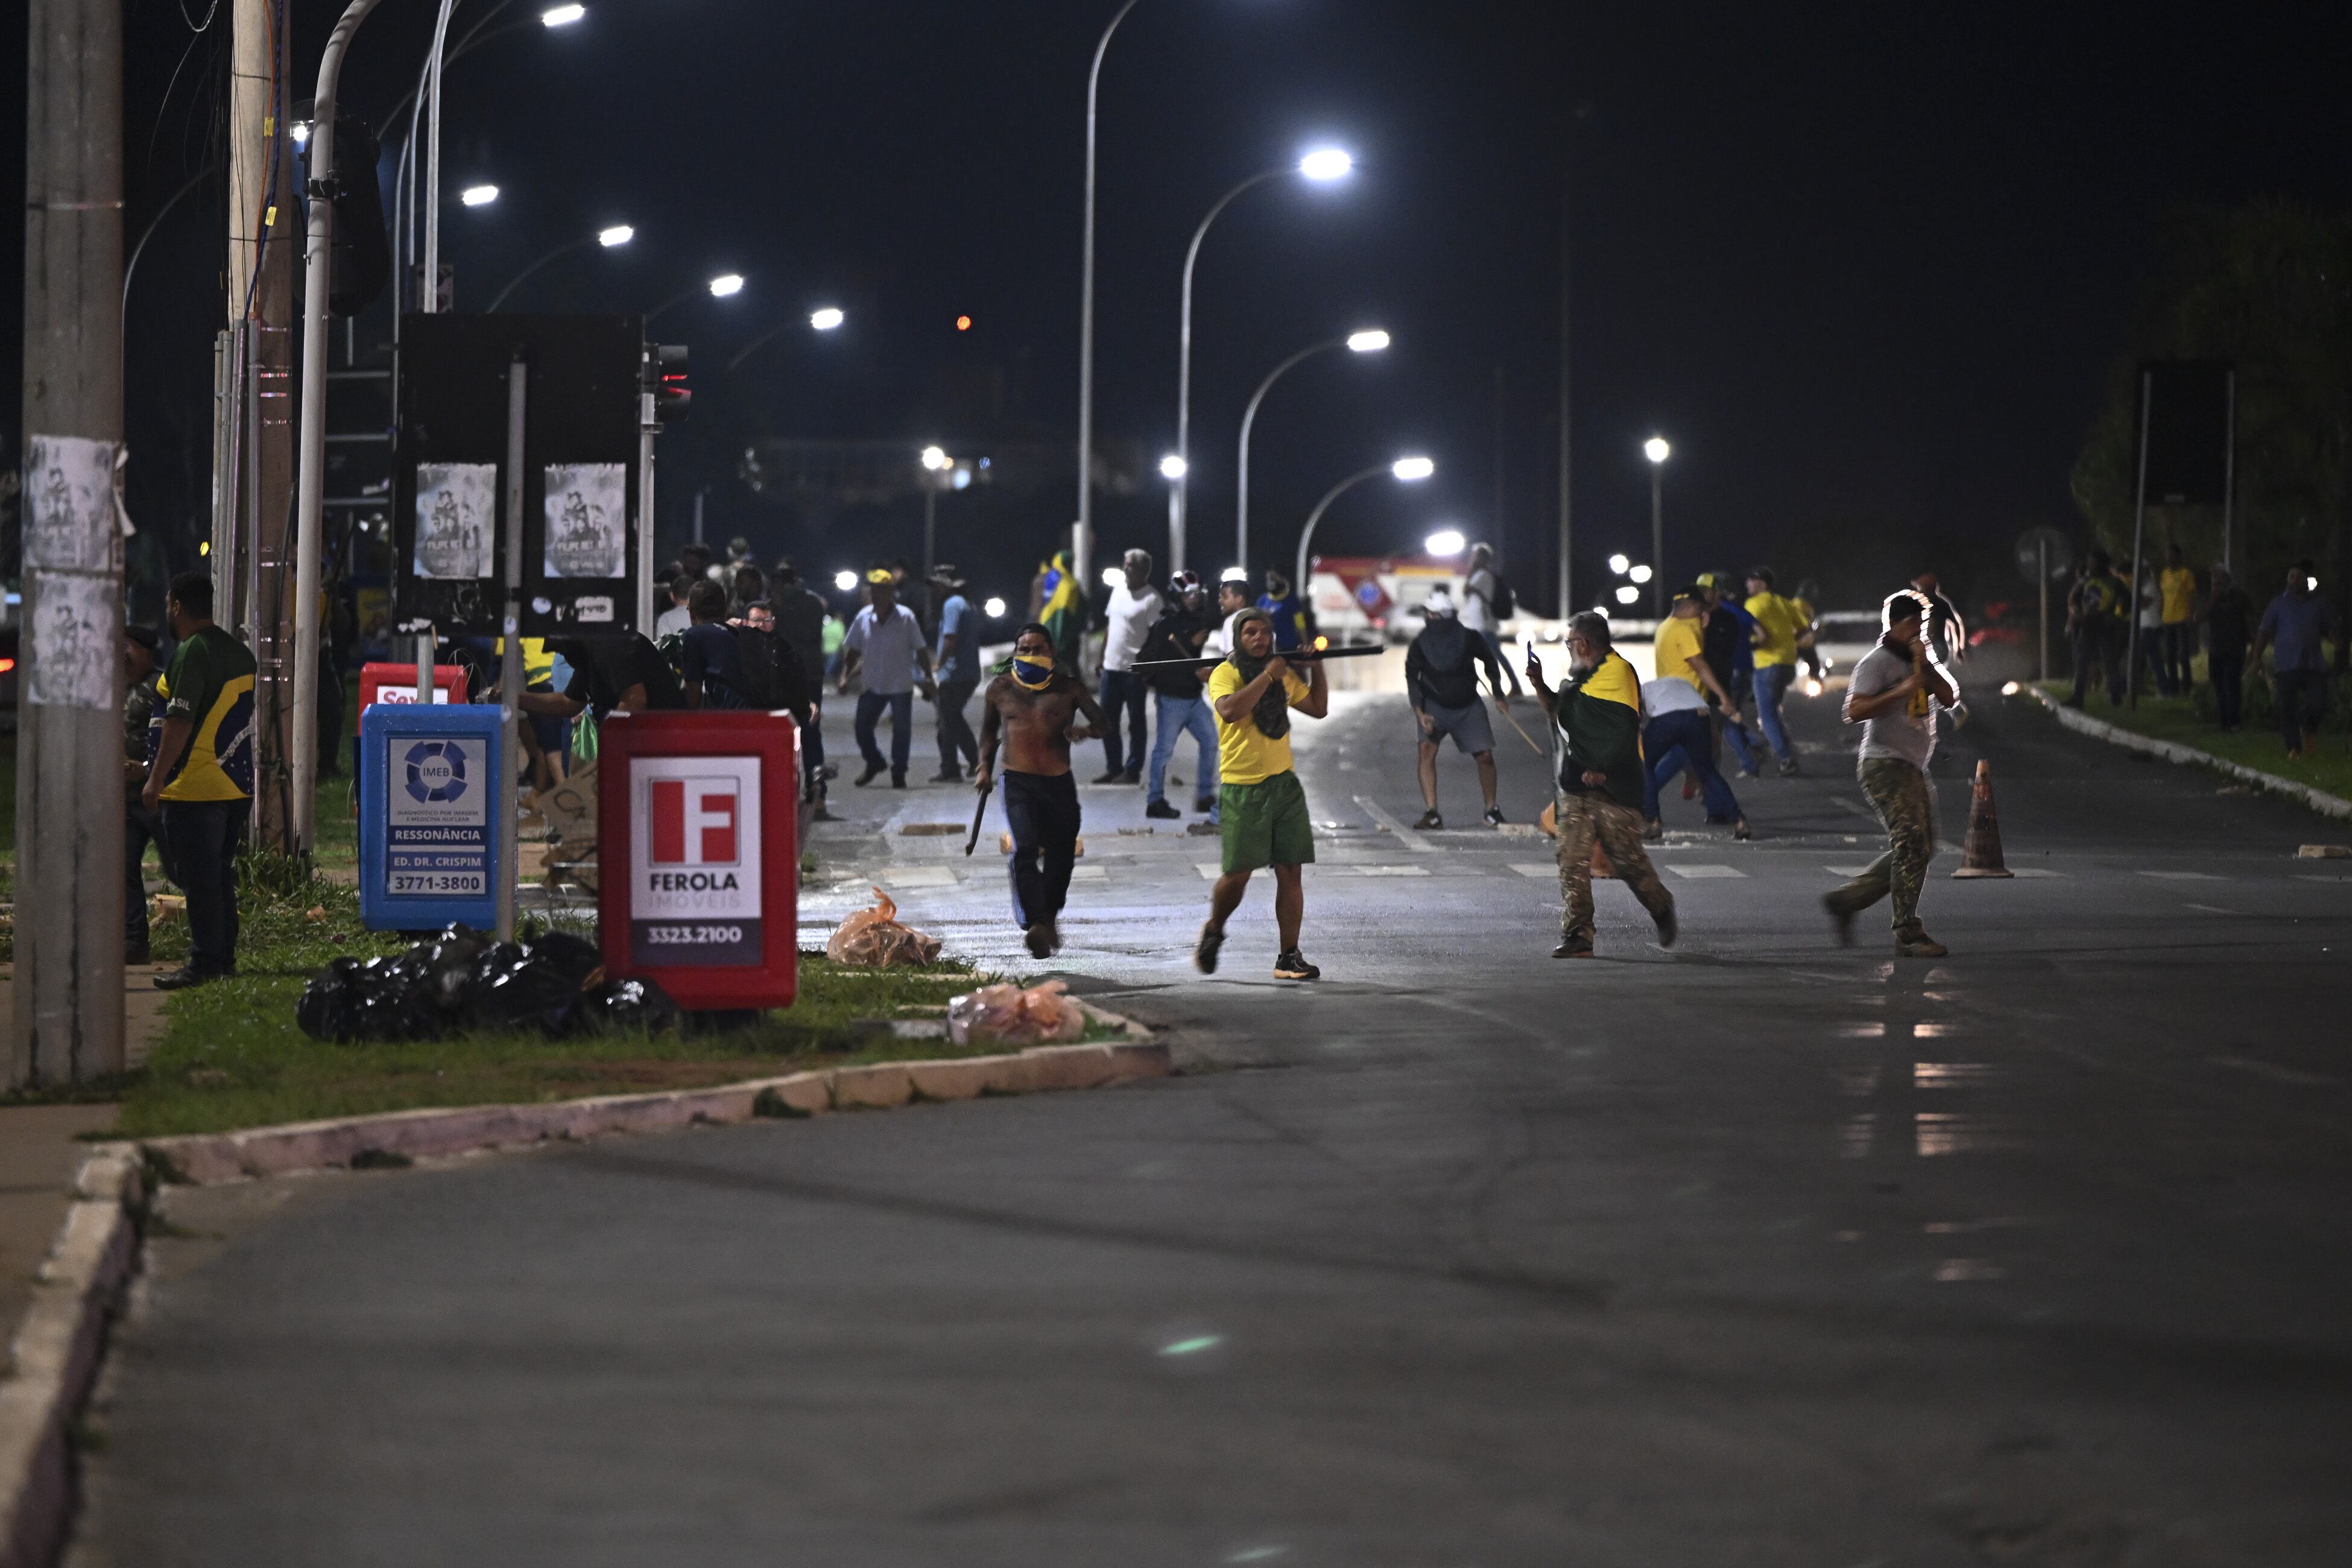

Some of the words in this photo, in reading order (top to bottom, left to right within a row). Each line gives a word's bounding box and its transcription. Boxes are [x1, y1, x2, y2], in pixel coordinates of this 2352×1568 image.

[167, 698, 190, 710] ASIL
[423, 767, 449, 777] IMEB
[395, 827, 481, 840] RESSONÂNCIA
[394, 857, 411, 866] ED.
[414, 857, 432, 867] DR.
[435, 857, 481, 867] CRISPIM
[395, 876, 480, 890] 3771-3800
[650, 872, 739, 891] FEROLA
[648, 926, 742, 943] 3323.2100
